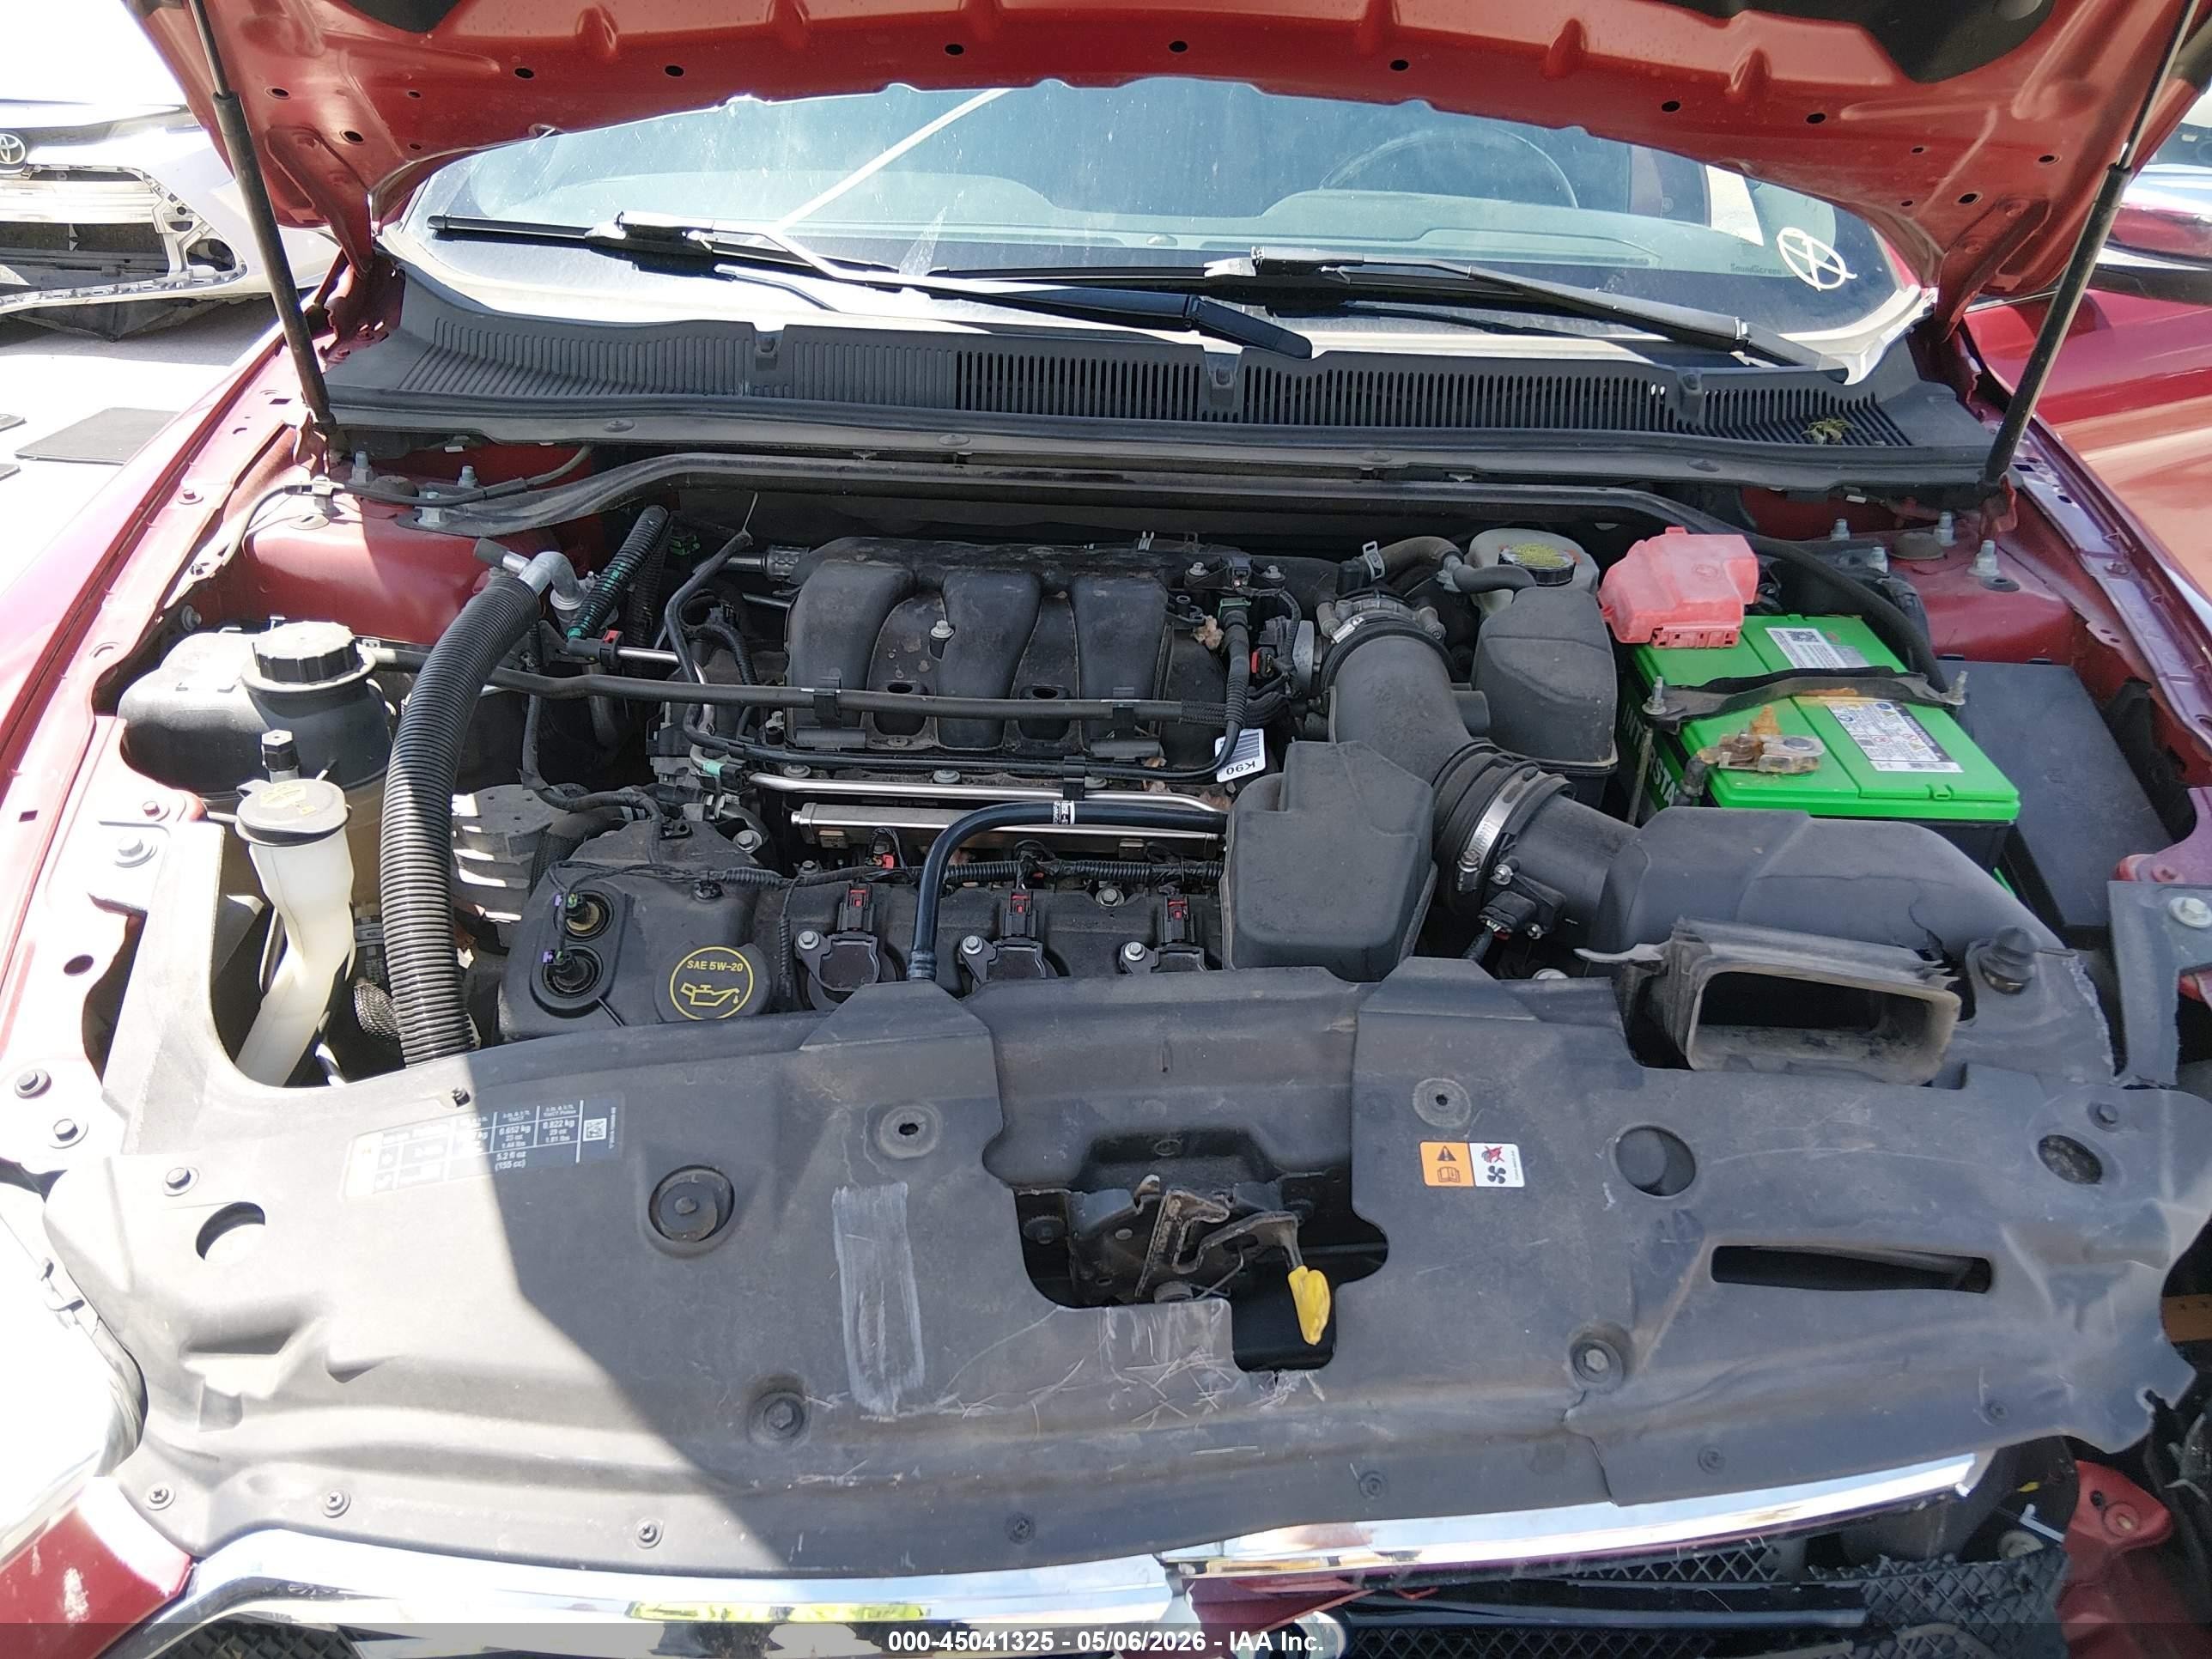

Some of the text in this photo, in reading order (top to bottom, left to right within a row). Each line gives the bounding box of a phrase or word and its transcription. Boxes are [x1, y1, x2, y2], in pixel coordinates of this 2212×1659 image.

[1730, 263, 1782, 276] SoundScreen
[1226, 761, 1255, 775] K90
[687, 960, 744, 972] SAE 5W-20
[564, 1119, 575, 1128] kg
